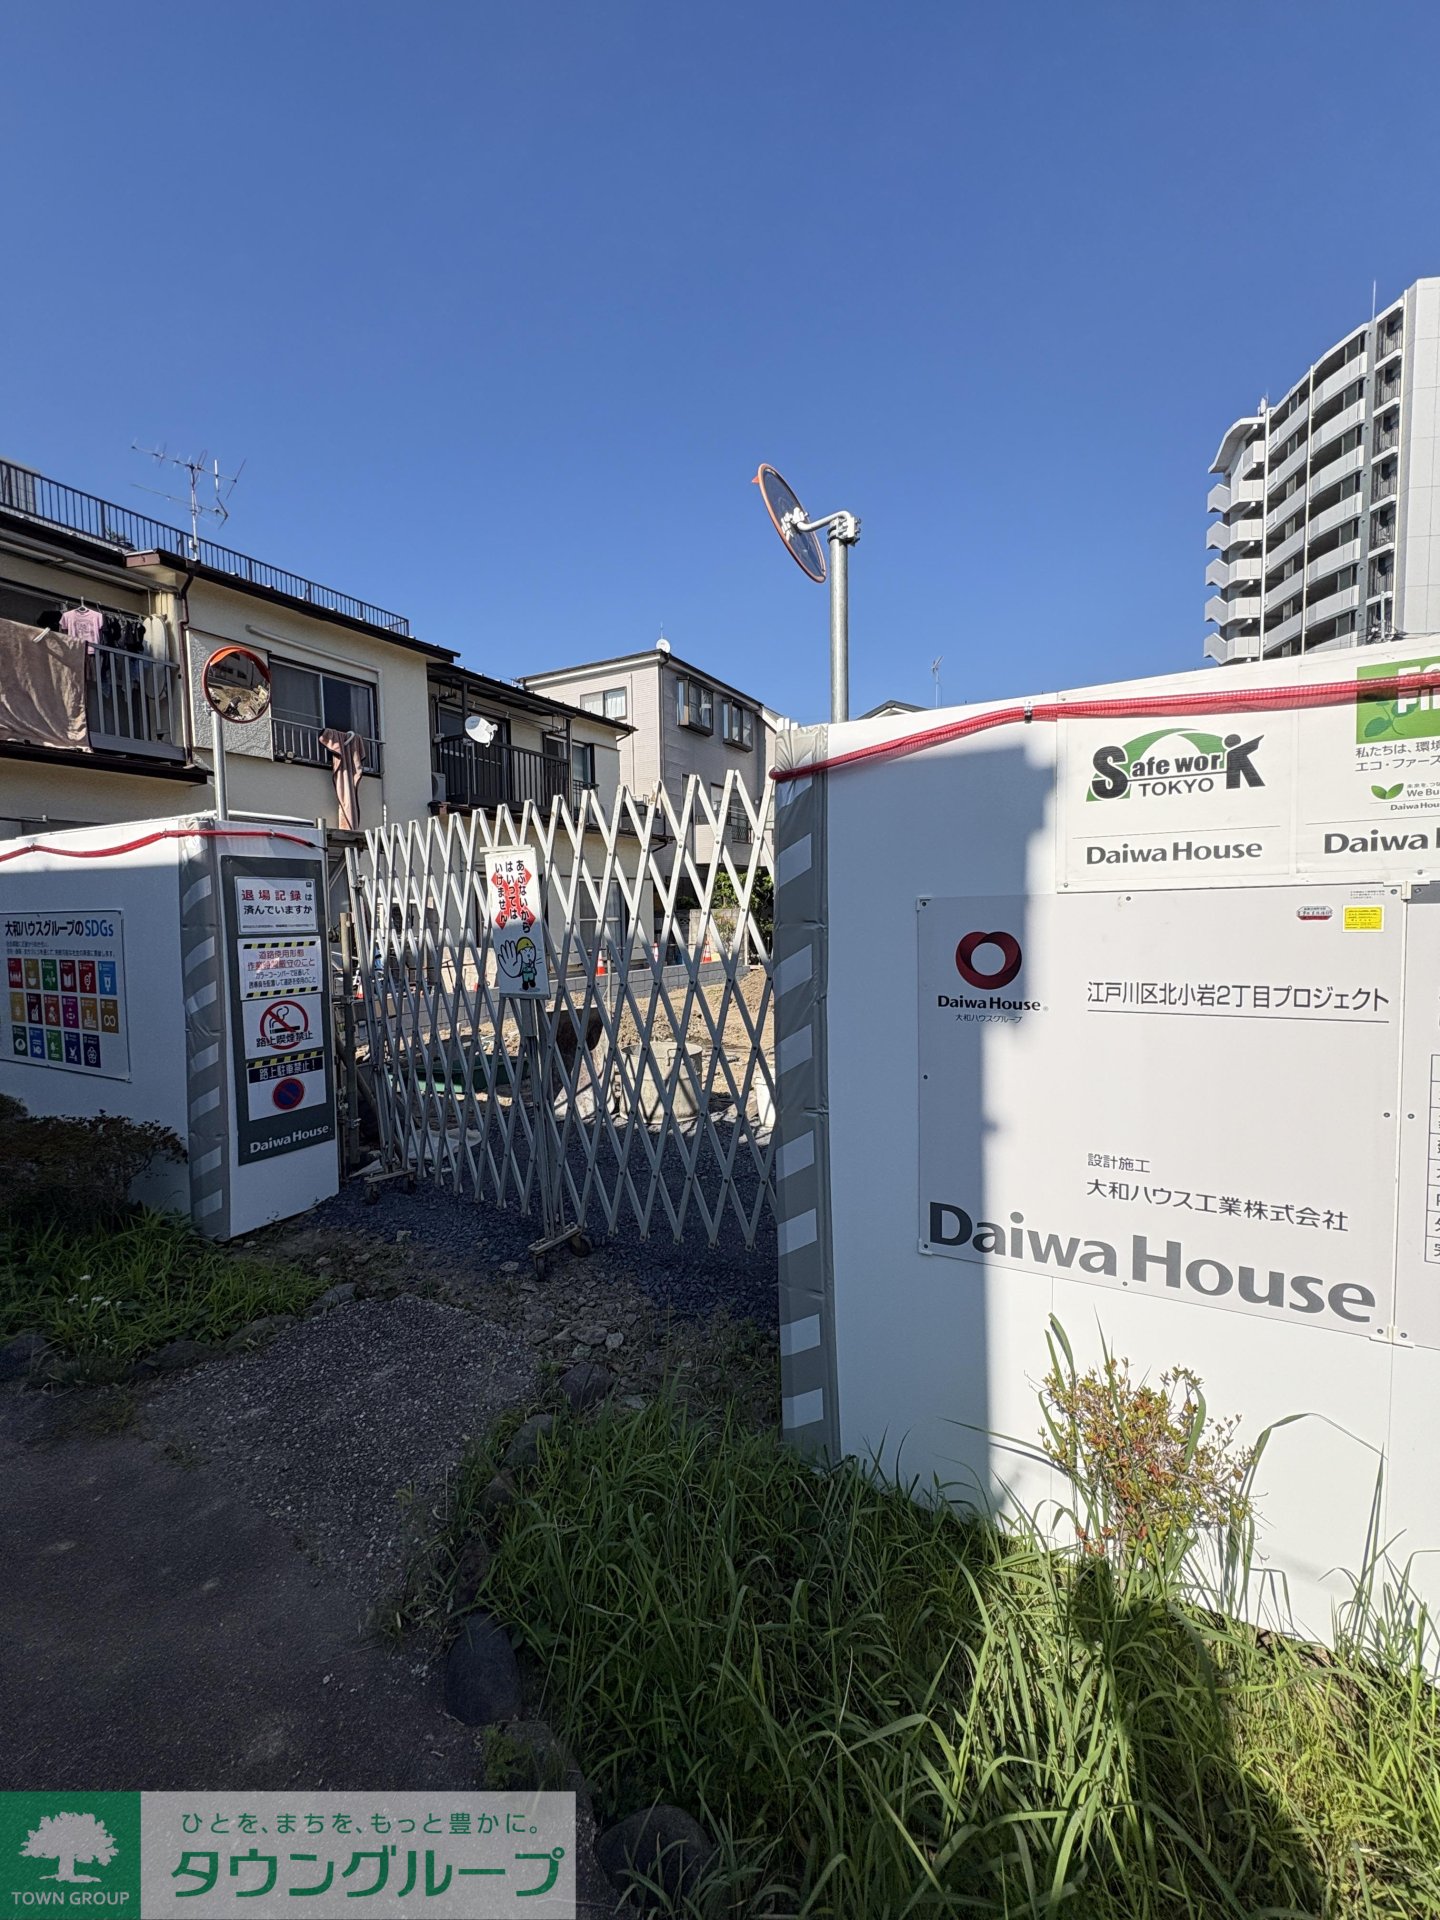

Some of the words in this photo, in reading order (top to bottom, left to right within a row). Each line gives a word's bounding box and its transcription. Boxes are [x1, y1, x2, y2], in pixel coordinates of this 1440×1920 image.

[1091, 745, 1170, 799] Safe
[1138, 778, 1214, 797] TOKYO
[1390, 803, 1419, 811] Daiwa
[1086, 843, 1167, 864] Daiwa
[1172, 841, 1263, 861] House
[1324, 829, 1428, 854] Daiwa
[495, 862, 508, 923] いけません
[505, 861, 518, 920] はいっては
[516, 860, 531, 933] あぶないから
[244, 905, 312, 915] 済んでいますか
[5, 920, 114, 937] 大和ハウスグループのSDGs
[937, 995, 987, 1009] Daiwa
[989, 997, 1041, 1010] House
[1087, 981, 1389, 1012] 江戸川区北小岩2丁目プロジェクト
[955, 1014, 1022, 1023] 大和ハウスグループ
[256, 1031, 313, 1047] 路上喫煙禁止
[249, 1137, 291, 1153] Daiwa
[293, 1125, 329, 1141] House
[1087, 1153, 1151, 1173] 設計施工
[1086, 1179, 1349, 1232] 大和ハウス工業株式会社
[929, 1201, 1117, 1277] Daiwa
[1132, 1235, 1376, 1323] House
